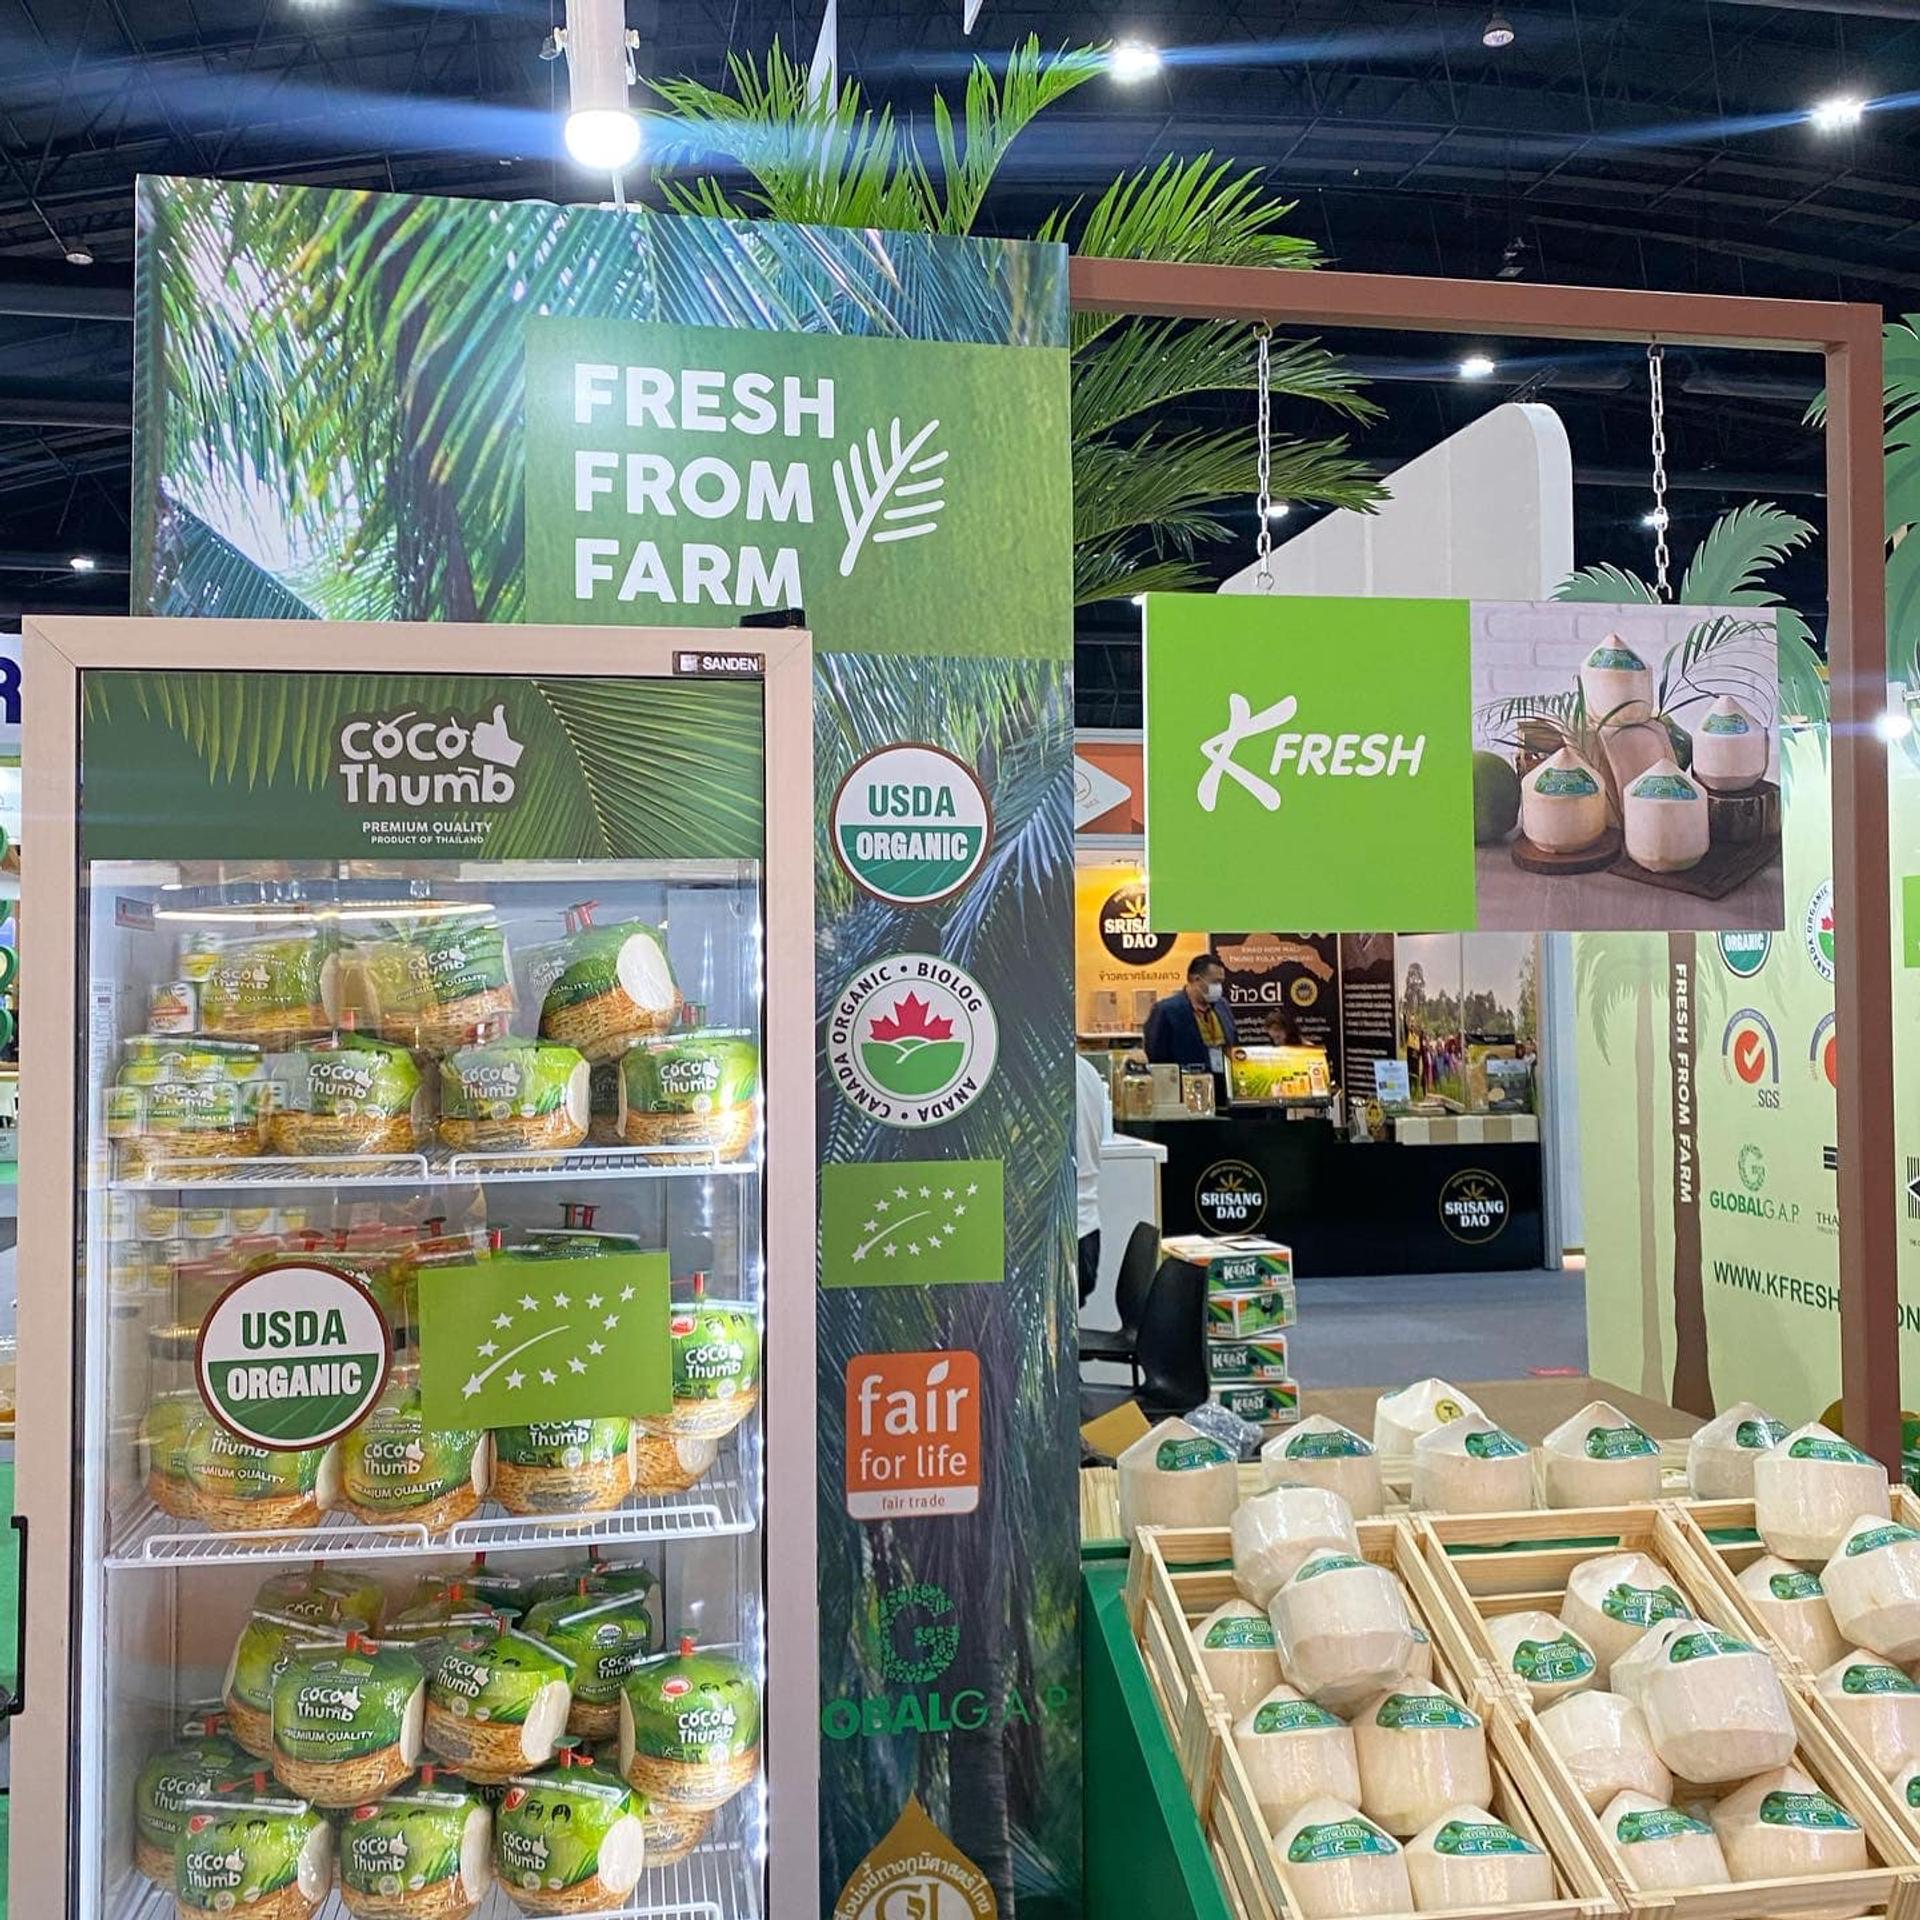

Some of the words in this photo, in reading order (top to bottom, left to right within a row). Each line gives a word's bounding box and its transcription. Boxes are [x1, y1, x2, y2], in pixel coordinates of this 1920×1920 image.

[574, 363, 835, 439] FRESH
[574, 450, 814, 523] FROM
[575, 537, 804, 609] FARM
[702, 656, 759, 672] SANDEN
[867, 784, 957, 818] USDA
[362, 821, 429, 834] PREMIUM
[432, 821, 493, 835] QUALITY
[370, 835, 417, 845] PRODUCT
[419, 835, 433, 845] OF
[435, 835, 485, 845] THAILAND
[855, 831, 969, 861] ORGANIC
[1122, 933, 1159, 949] DAO
[1724, 933, 1764, 952] ORGANIC
[1260, 982, 1282, 1002] GI
[831, 965, 893, 1044] ORGANIC
[1674, 963, 1689, 1044] FRESH
[832, 1052, 892, 1119] CANADA
[1677, 1052, 1691, 1125] FROM
[1758, 1088, 1780, 1108] SGS
[1679, 1133, 1693, 1204] FARM
[1201, 1192, 1262, 1206] SRISANG
[1444, 1200, 1504, 1215] SRISANG
[1216, 1206, 1247, 1219] DAO
[1460, 1214, 1490, 1228] DAO
[241, 1308, 347, 1351] USDA
[227, 1361, 362, 1401] ORGANIC
[858, 1360, 970, 1437] fair
[859, 1448, 907, 1481] for
[916, 1443, 968, 1478] life
[236, 1468, 286, 1484] QUALITY
[393, 1480, 444, 1498] QUALITY
[882, 1496, 905, 1510] fair
[908, 1493, 946, 1508] trade
[326, 1729, 375, 1743] QUALITY
